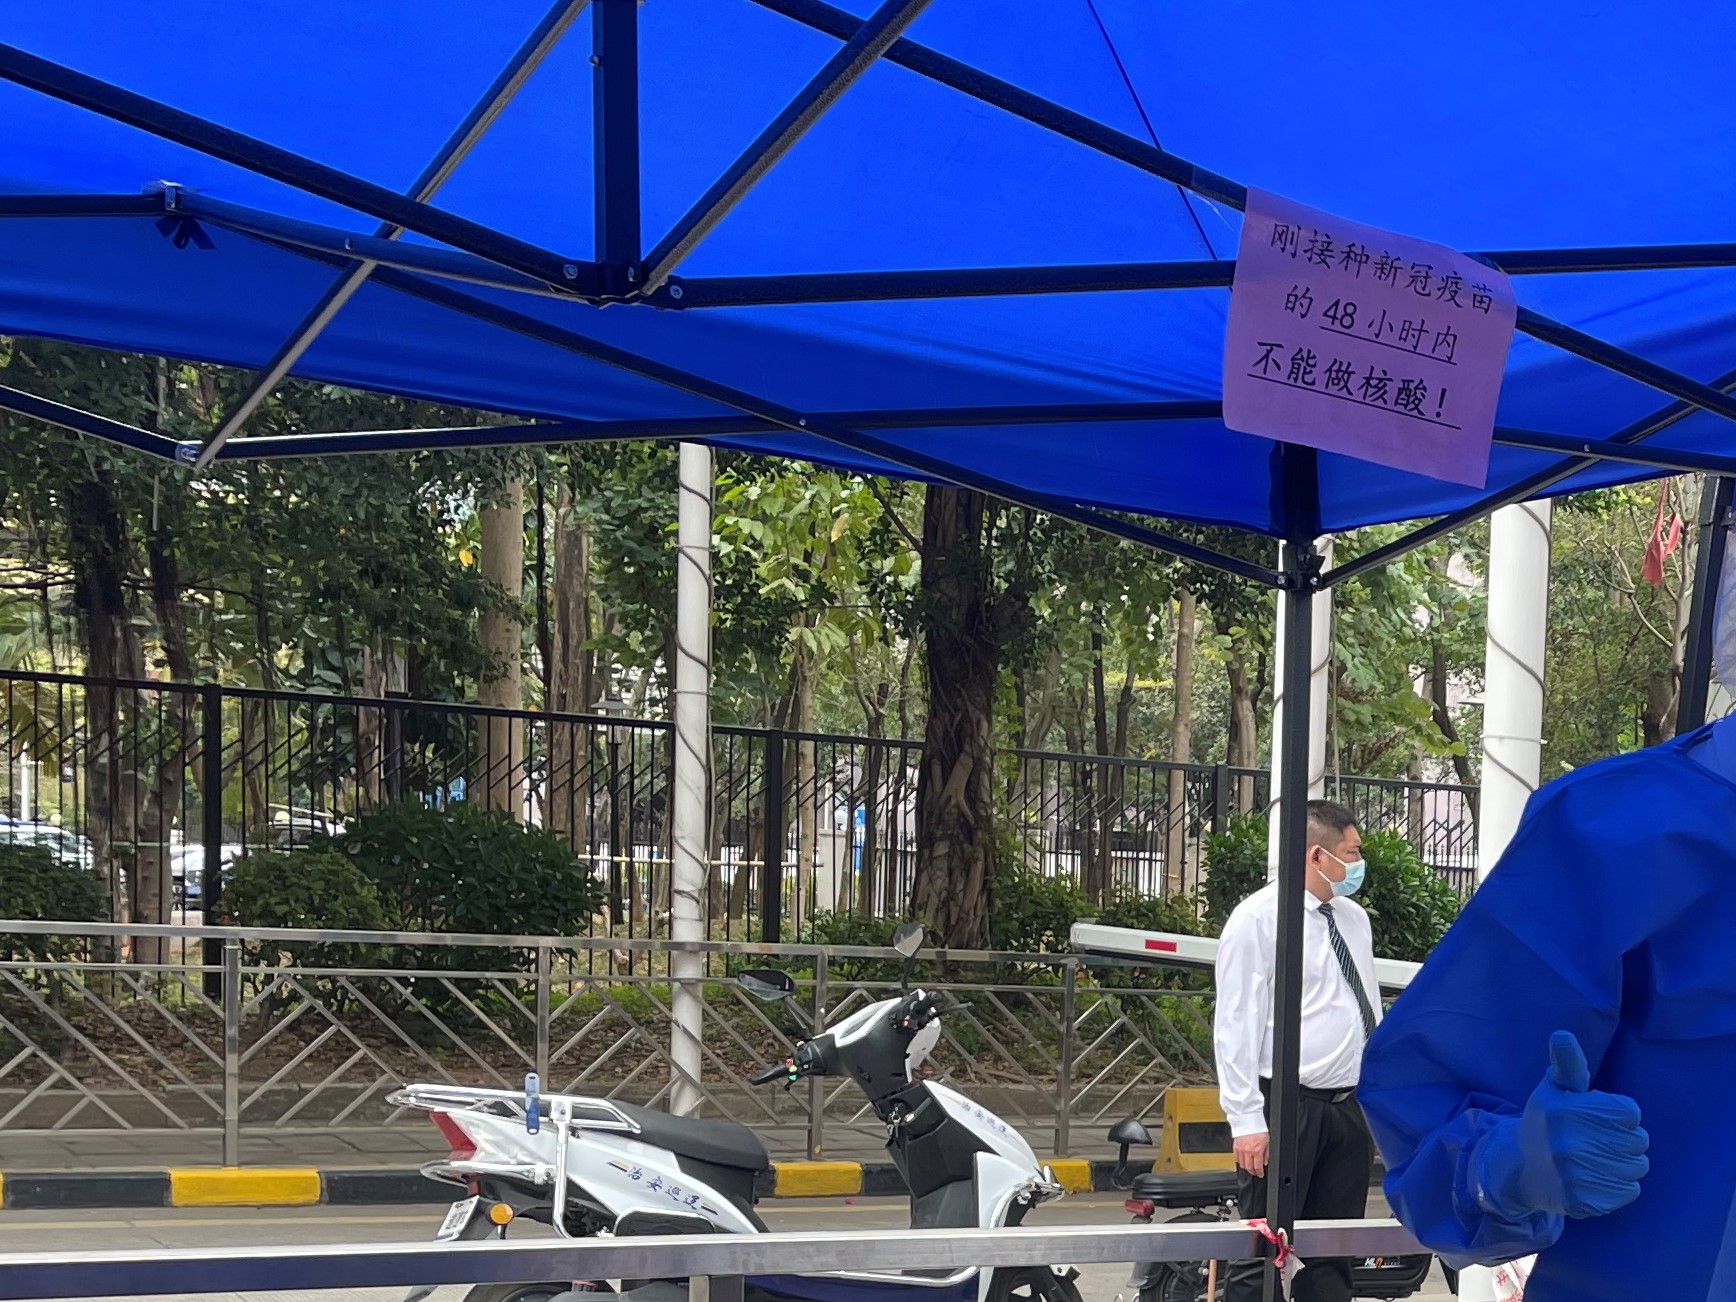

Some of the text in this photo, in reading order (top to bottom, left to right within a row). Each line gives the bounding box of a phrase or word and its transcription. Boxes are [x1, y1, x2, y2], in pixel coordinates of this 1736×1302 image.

[1269, 222, 1494, 315] 刚接种新冠疫苗
[1252, 340, 1448, 419] 不能做核酸！
